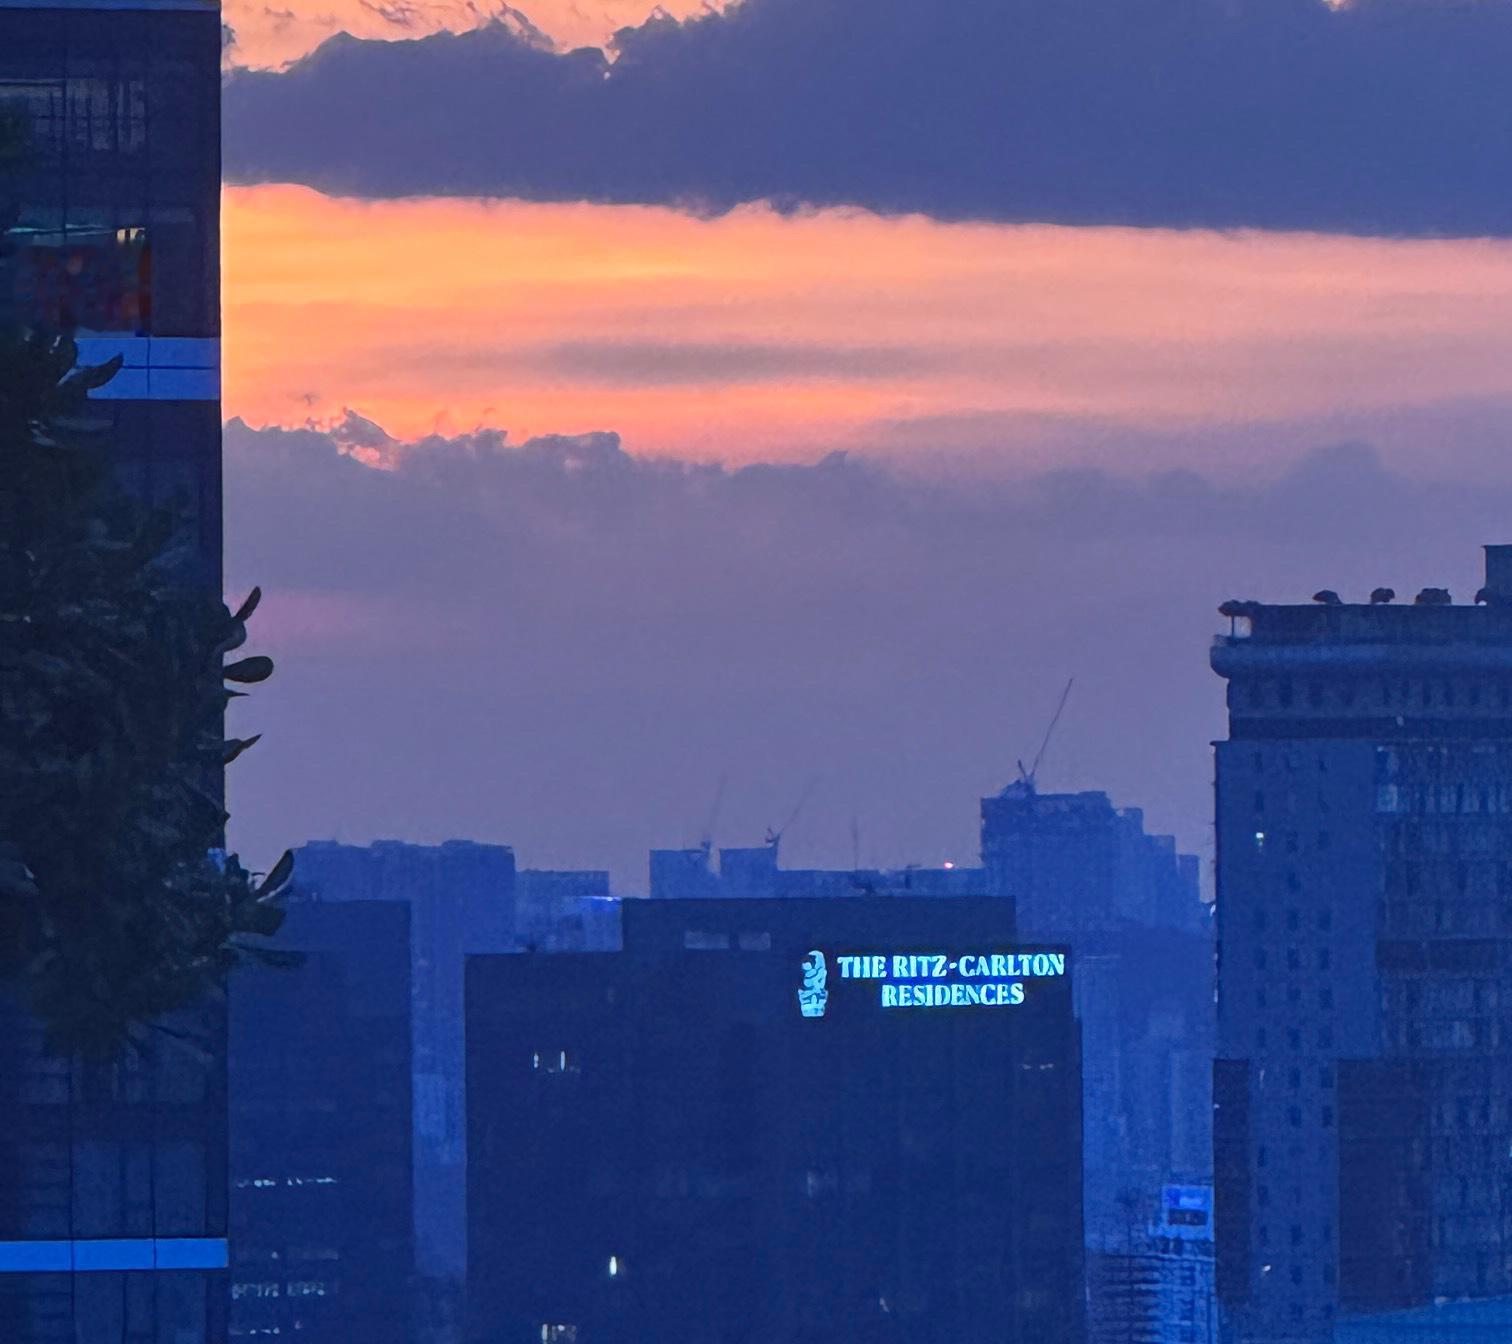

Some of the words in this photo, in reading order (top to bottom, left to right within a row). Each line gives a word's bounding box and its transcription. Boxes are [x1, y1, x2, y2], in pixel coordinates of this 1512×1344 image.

[837, 955, 887, 978] THE
[893, 953, 1065, 978] RITZ-CARLTON
[881, 983, 1025, 1006] RESIDENCES
